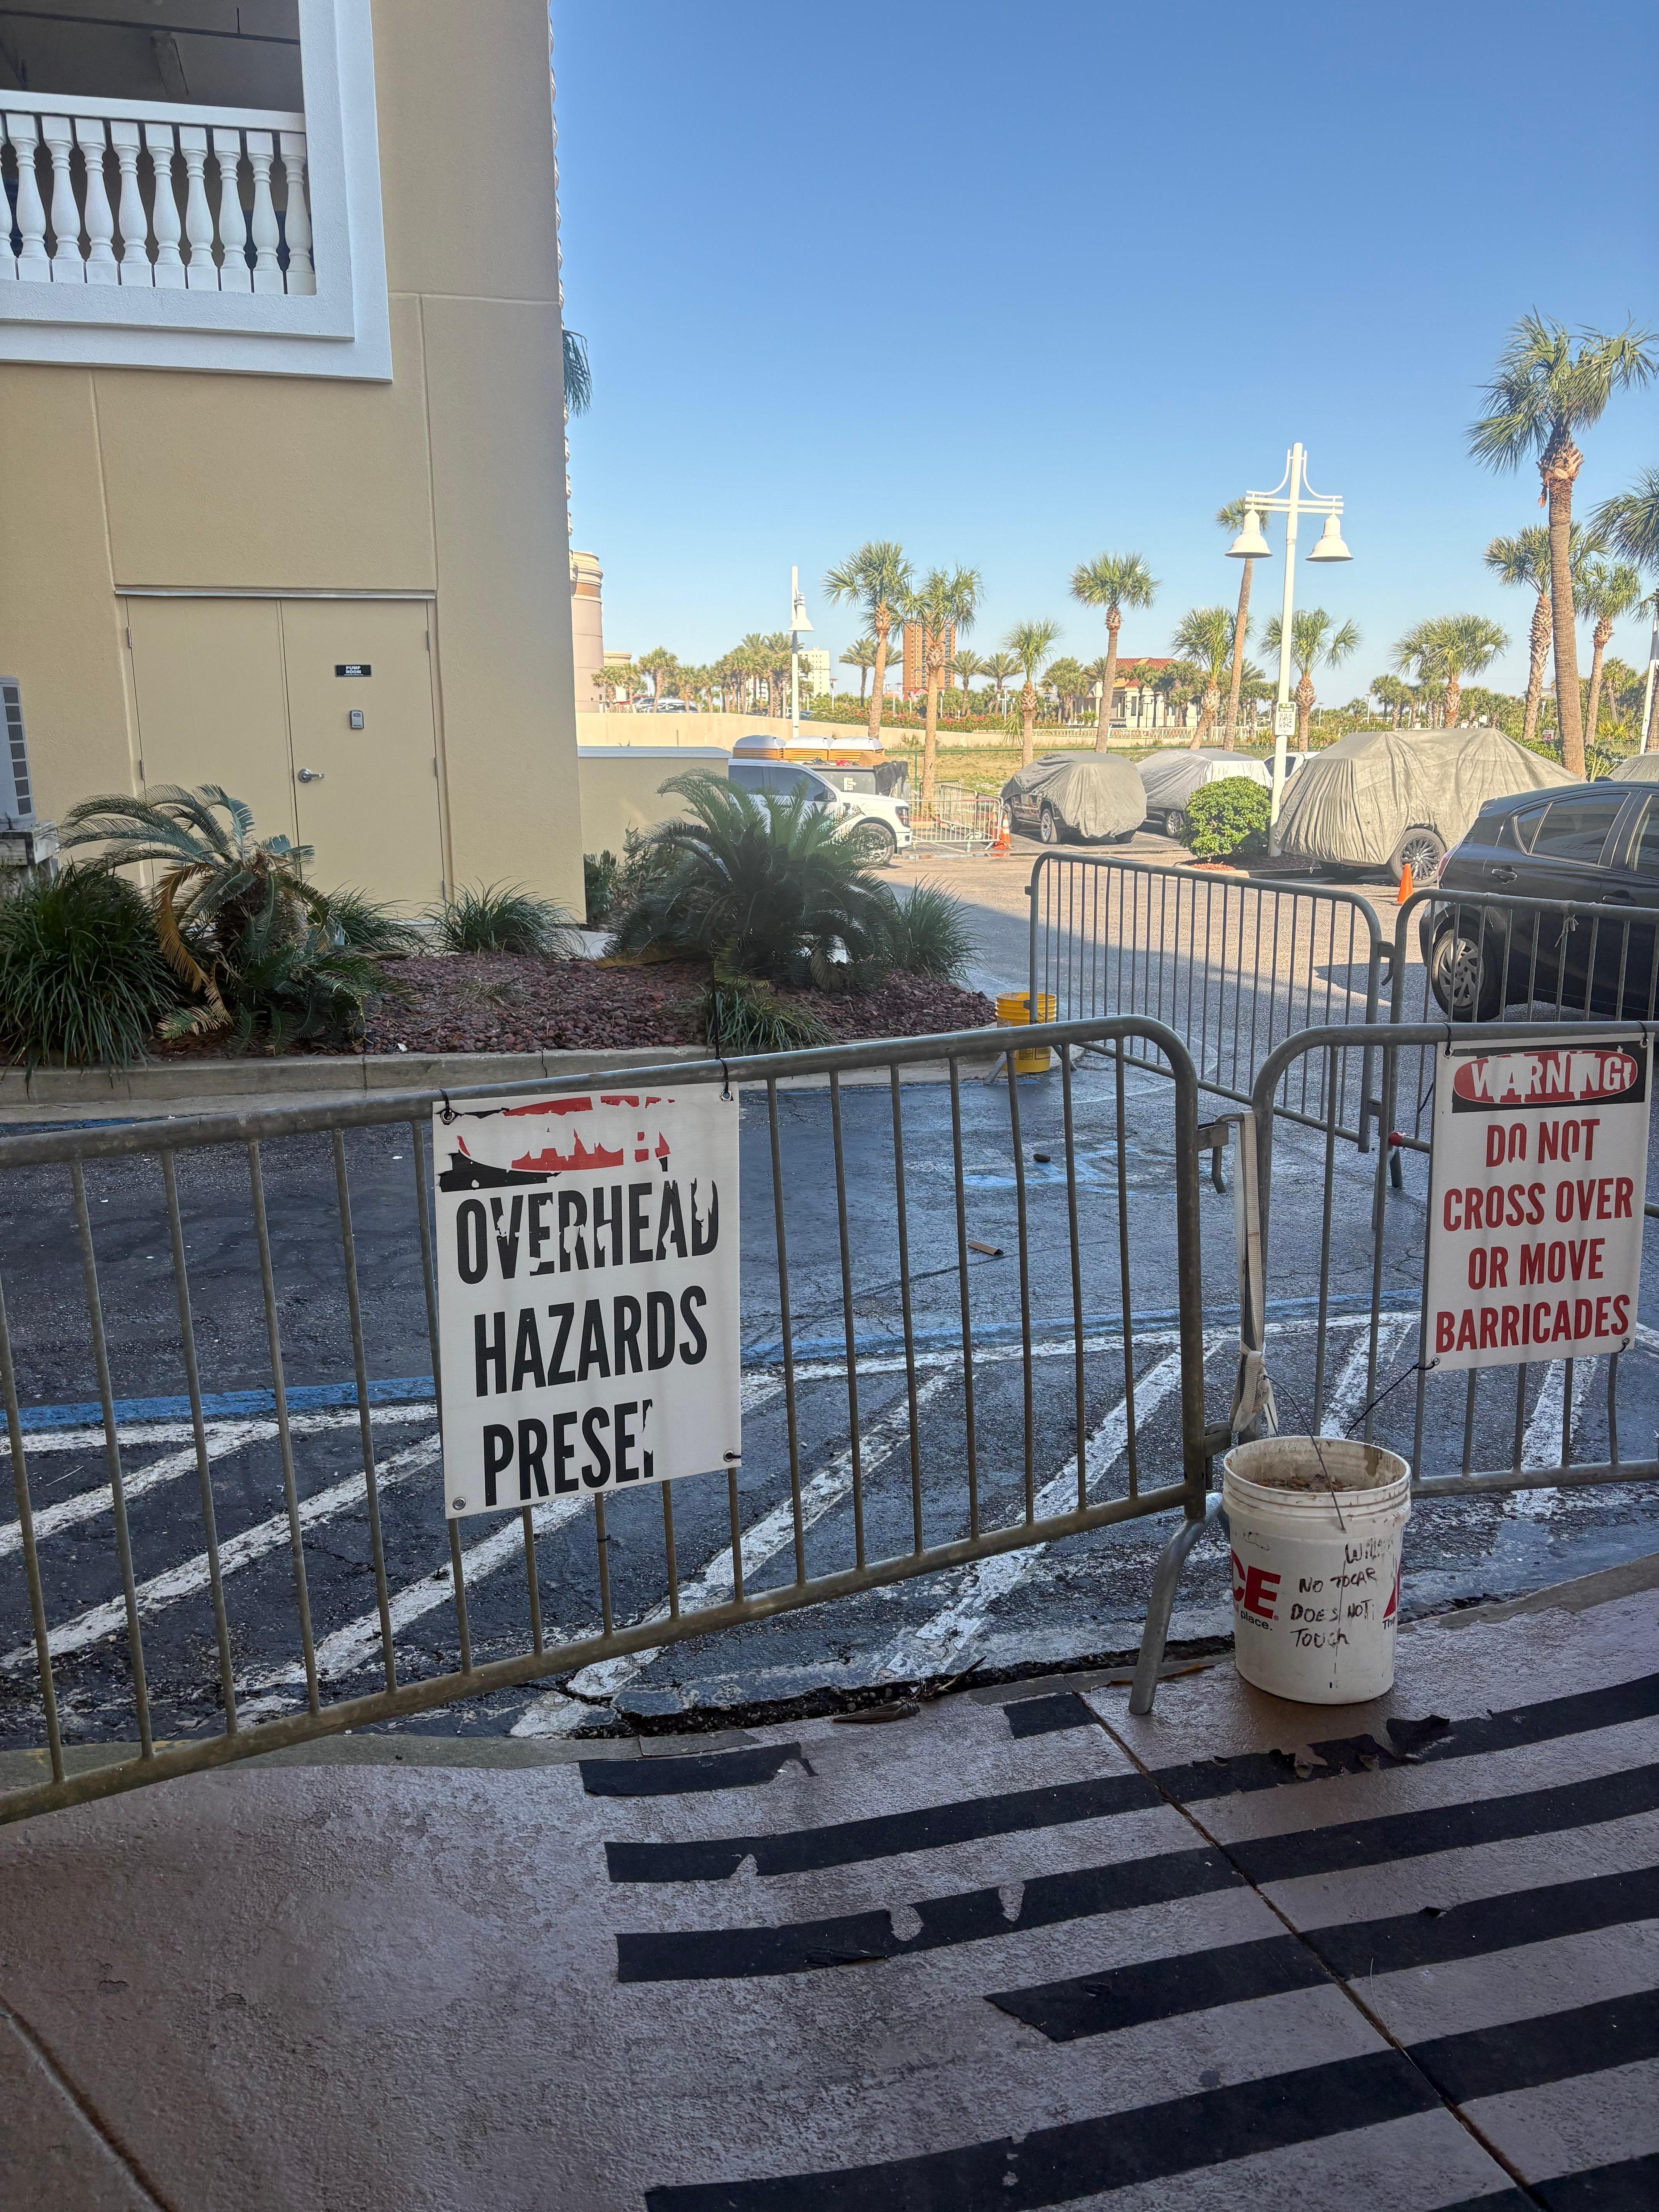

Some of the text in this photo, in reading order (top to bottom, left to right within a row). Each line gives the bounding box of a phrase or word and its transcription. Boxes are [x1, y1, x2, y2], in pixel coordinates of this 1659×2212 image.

[1486, 1119, 1600, 1167] DO NOT
[1443, 1177, 1633, 1232] CROSS OVER
[456, 1178, 719, 1284] OVERHEAD
[1468, 1238, 1605, 1290] OR MOVE
[474, 1285, 708, 1397] HAZARDS
[1436, 1295, 1630, 1353] BARRICADES
[1290, 1599, 1372, 1623] DOES NOT
[1299, 1577, 1323, 1593] NO
[1240, 1610, 1273, 1631] place.
